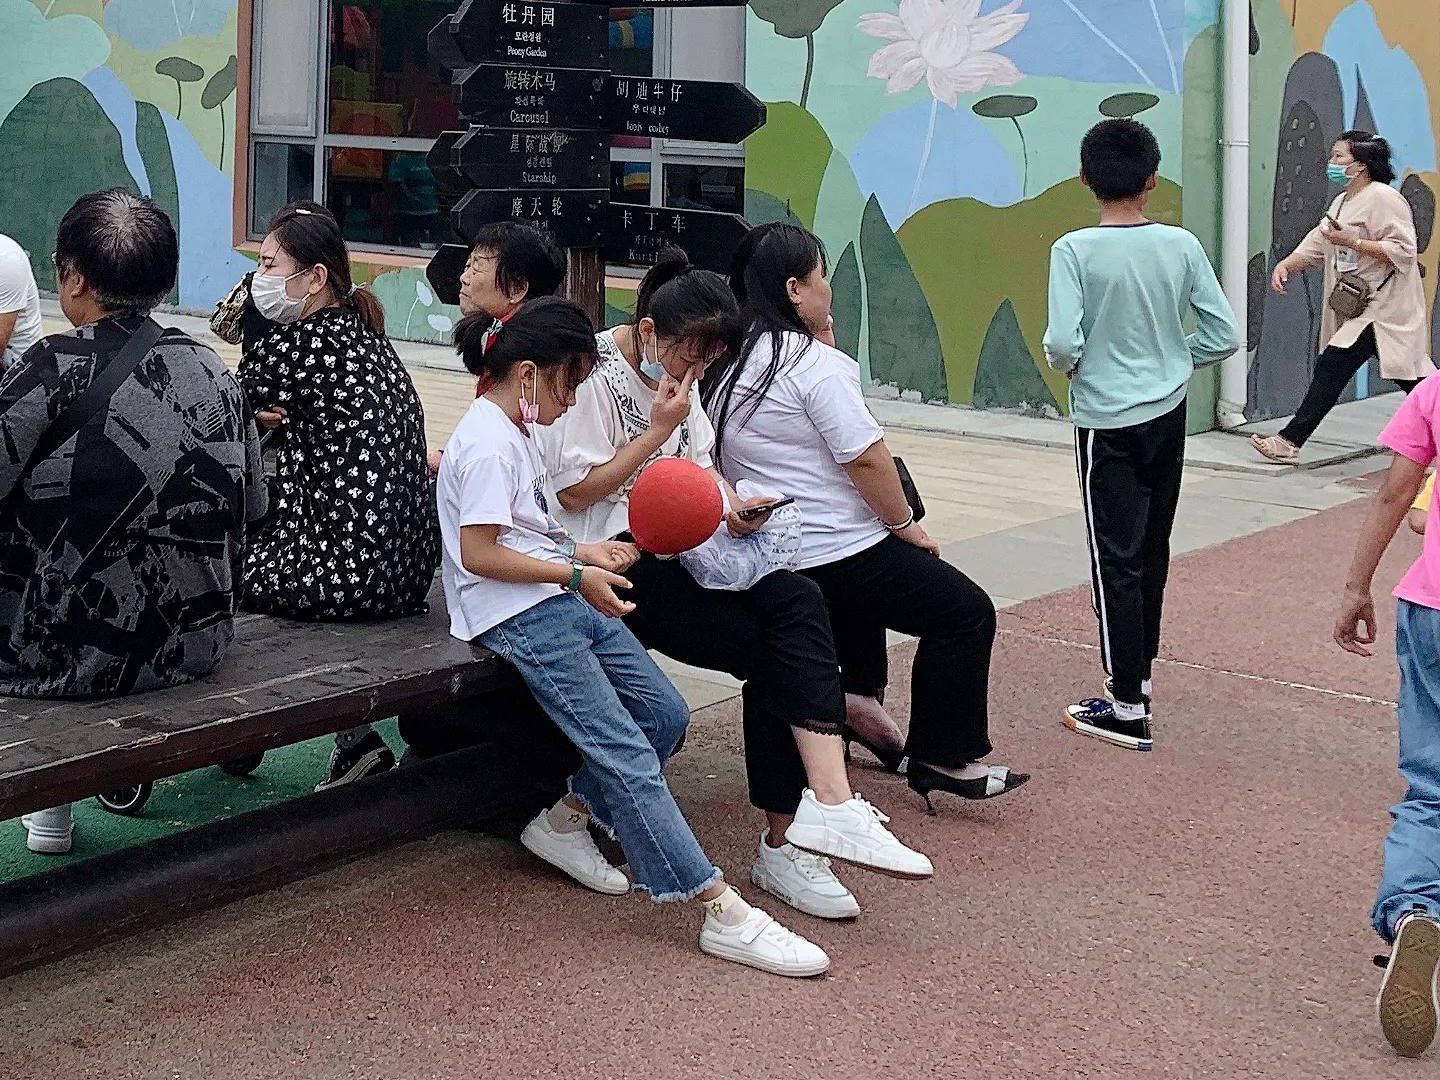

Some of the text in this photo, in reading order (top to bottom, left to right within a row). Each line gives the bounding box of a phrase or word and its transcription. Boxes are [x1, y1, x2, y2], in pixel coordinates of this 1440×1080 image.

[502, 3, 555, 27] 牡丹园
[525, 46, 547, 58] Garden
[503, 70, 556, 91] 旋转木马
[510, 109, 550, 124] Carousel
[522, 171, 558, 185] Starship
[511, 196, 563, 217] 摩天轮
[620, 209, 686, 233] 卡丁车
